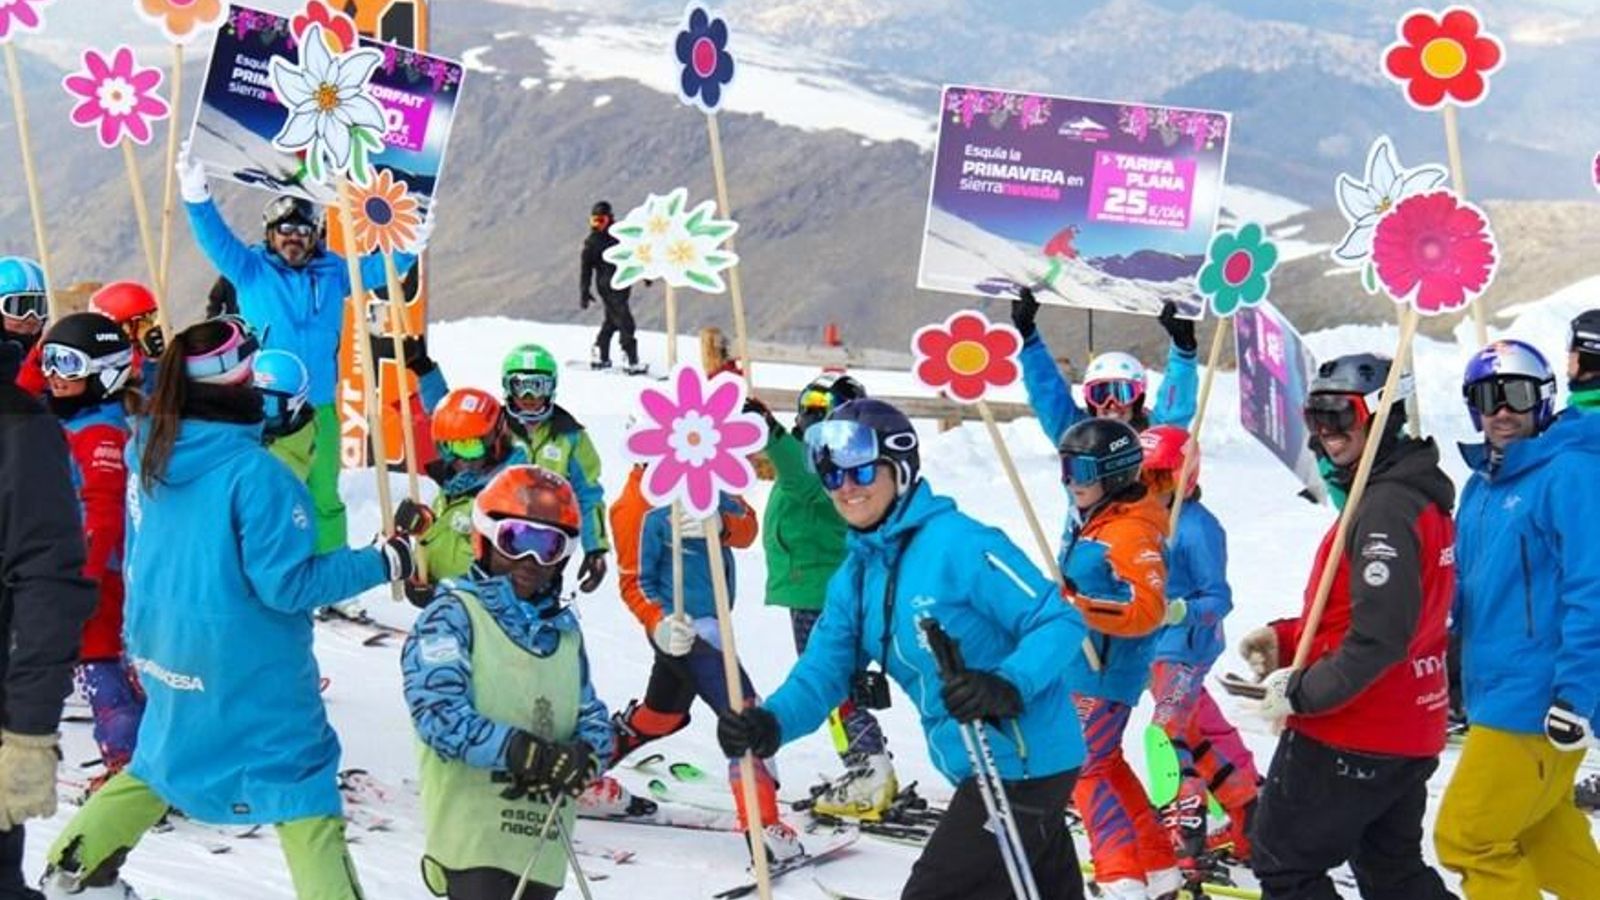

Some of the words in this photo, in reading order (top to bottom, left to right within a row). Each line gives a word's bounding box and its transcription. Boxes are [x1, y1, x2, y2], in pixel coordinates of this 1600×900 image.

[964, 143, 1008, 160] Esquía
[1009, 148, 1022, 161] la
[962, 160, 1066, 186] PRIMAVERA
[1066, 175, 1084, 187] en
[1115, 154, 1175, 174] TARIFA
[1125, 172, 1186, 192] PLANA
[1103, 186, 1148, 216] 25
